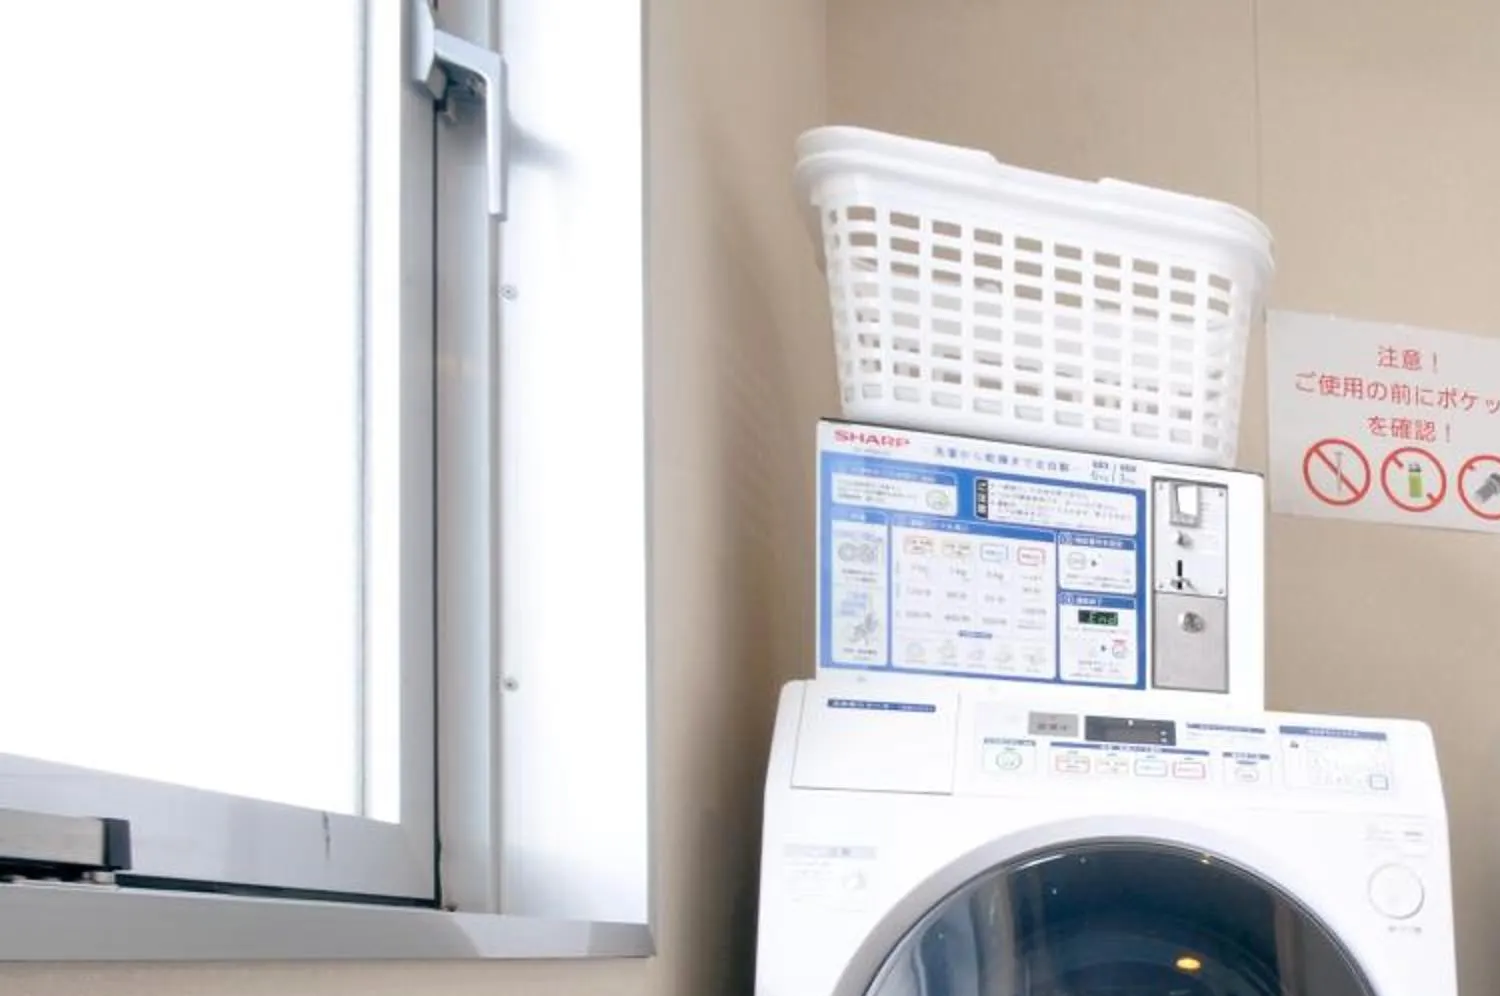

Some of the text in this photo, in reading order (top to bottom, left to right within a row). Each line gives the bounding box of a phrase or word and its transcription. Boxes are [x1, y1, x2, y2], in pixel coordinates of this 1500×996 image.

[1377, 345, 1438, 373] 注意！
[834, 428, 910, 448] SHARP
[1368, 415, 1451, 443] を確認！
